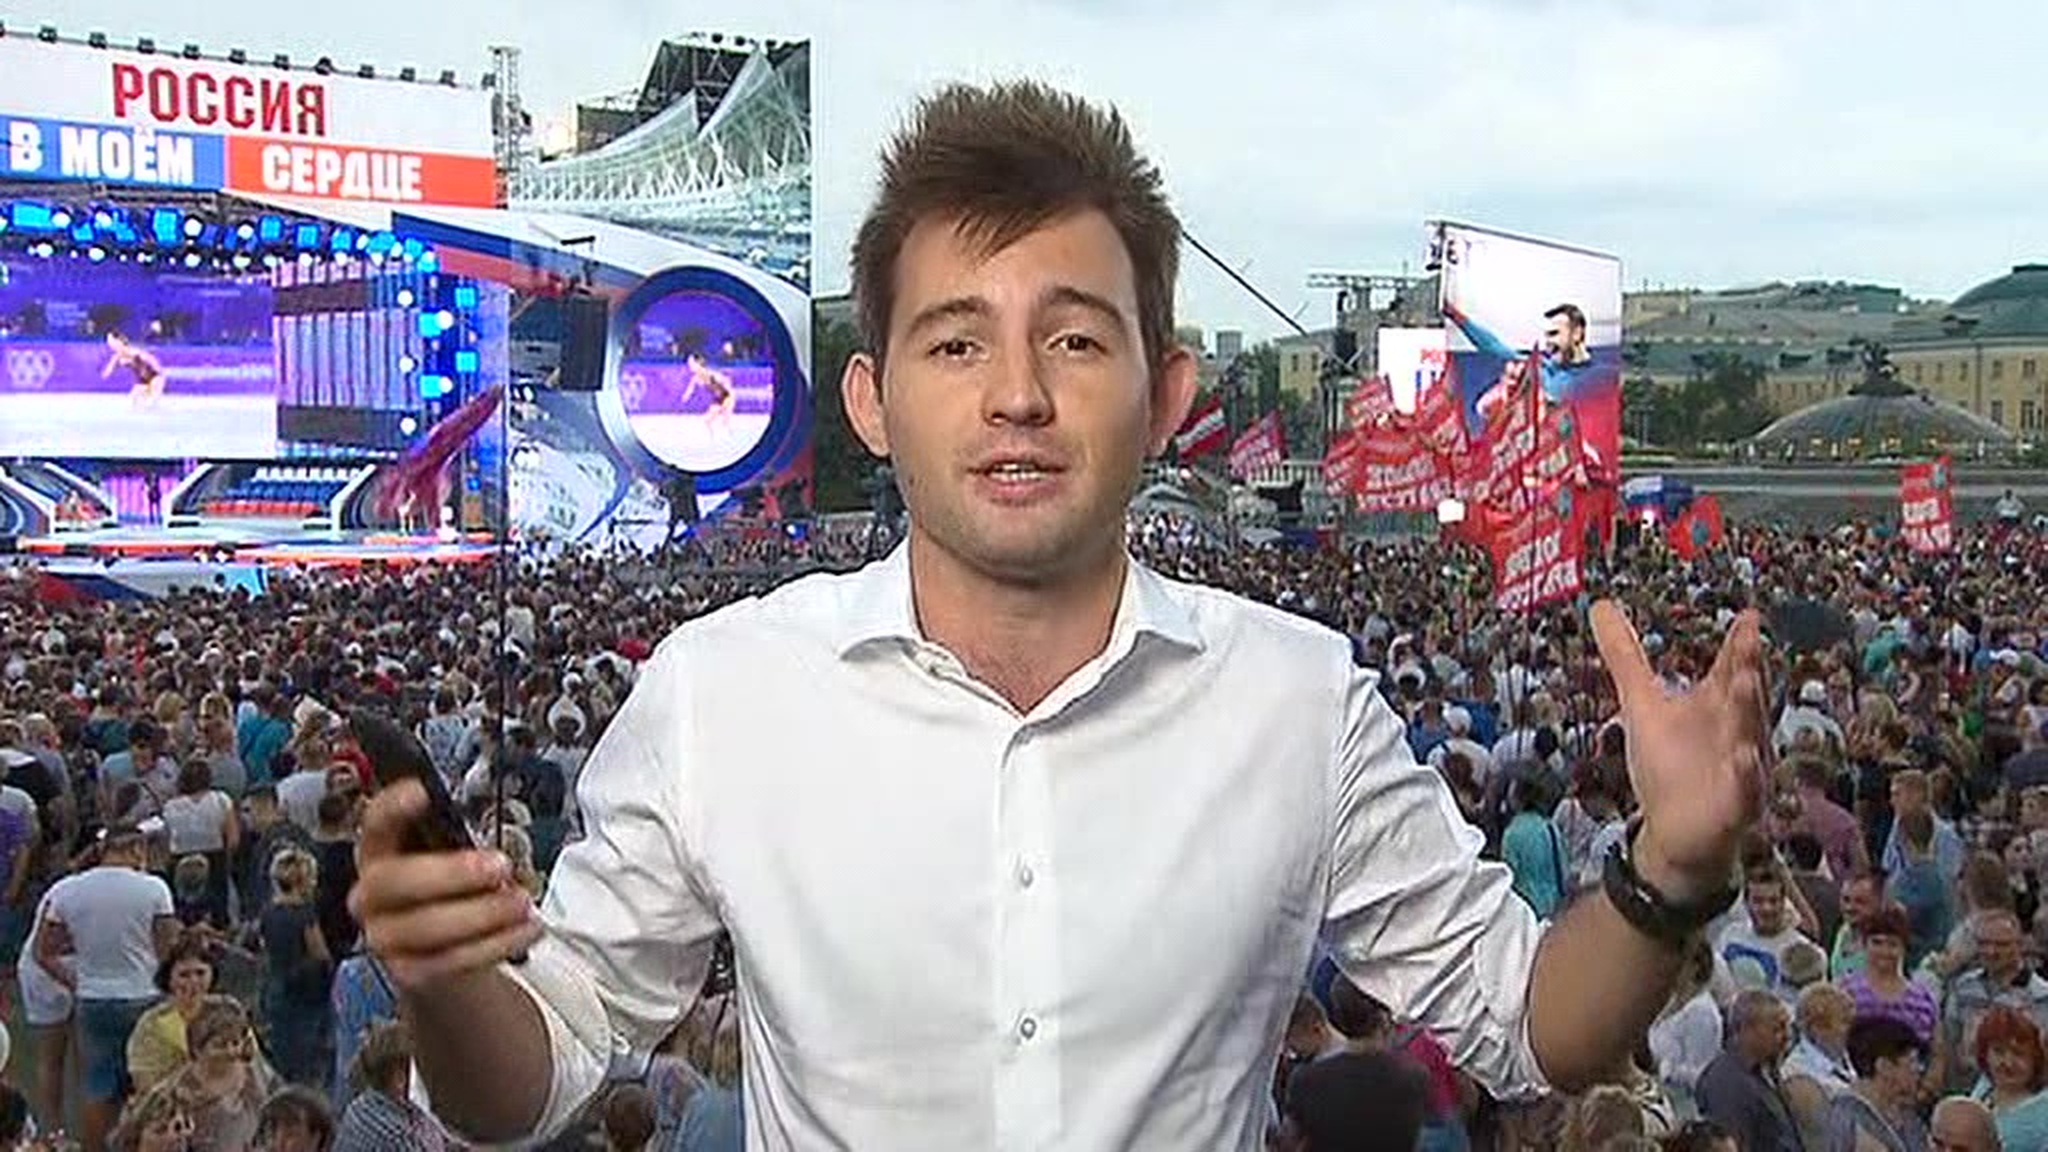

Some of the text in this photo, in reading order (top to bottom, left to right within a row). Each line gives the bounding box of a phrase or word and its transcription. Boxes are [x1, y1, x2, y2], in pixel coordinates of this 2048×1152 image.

[112, 62, 326, 136] РОССИЯ
[9, 121, 423, 201] В МОЁМ СЕРДЦЕ
